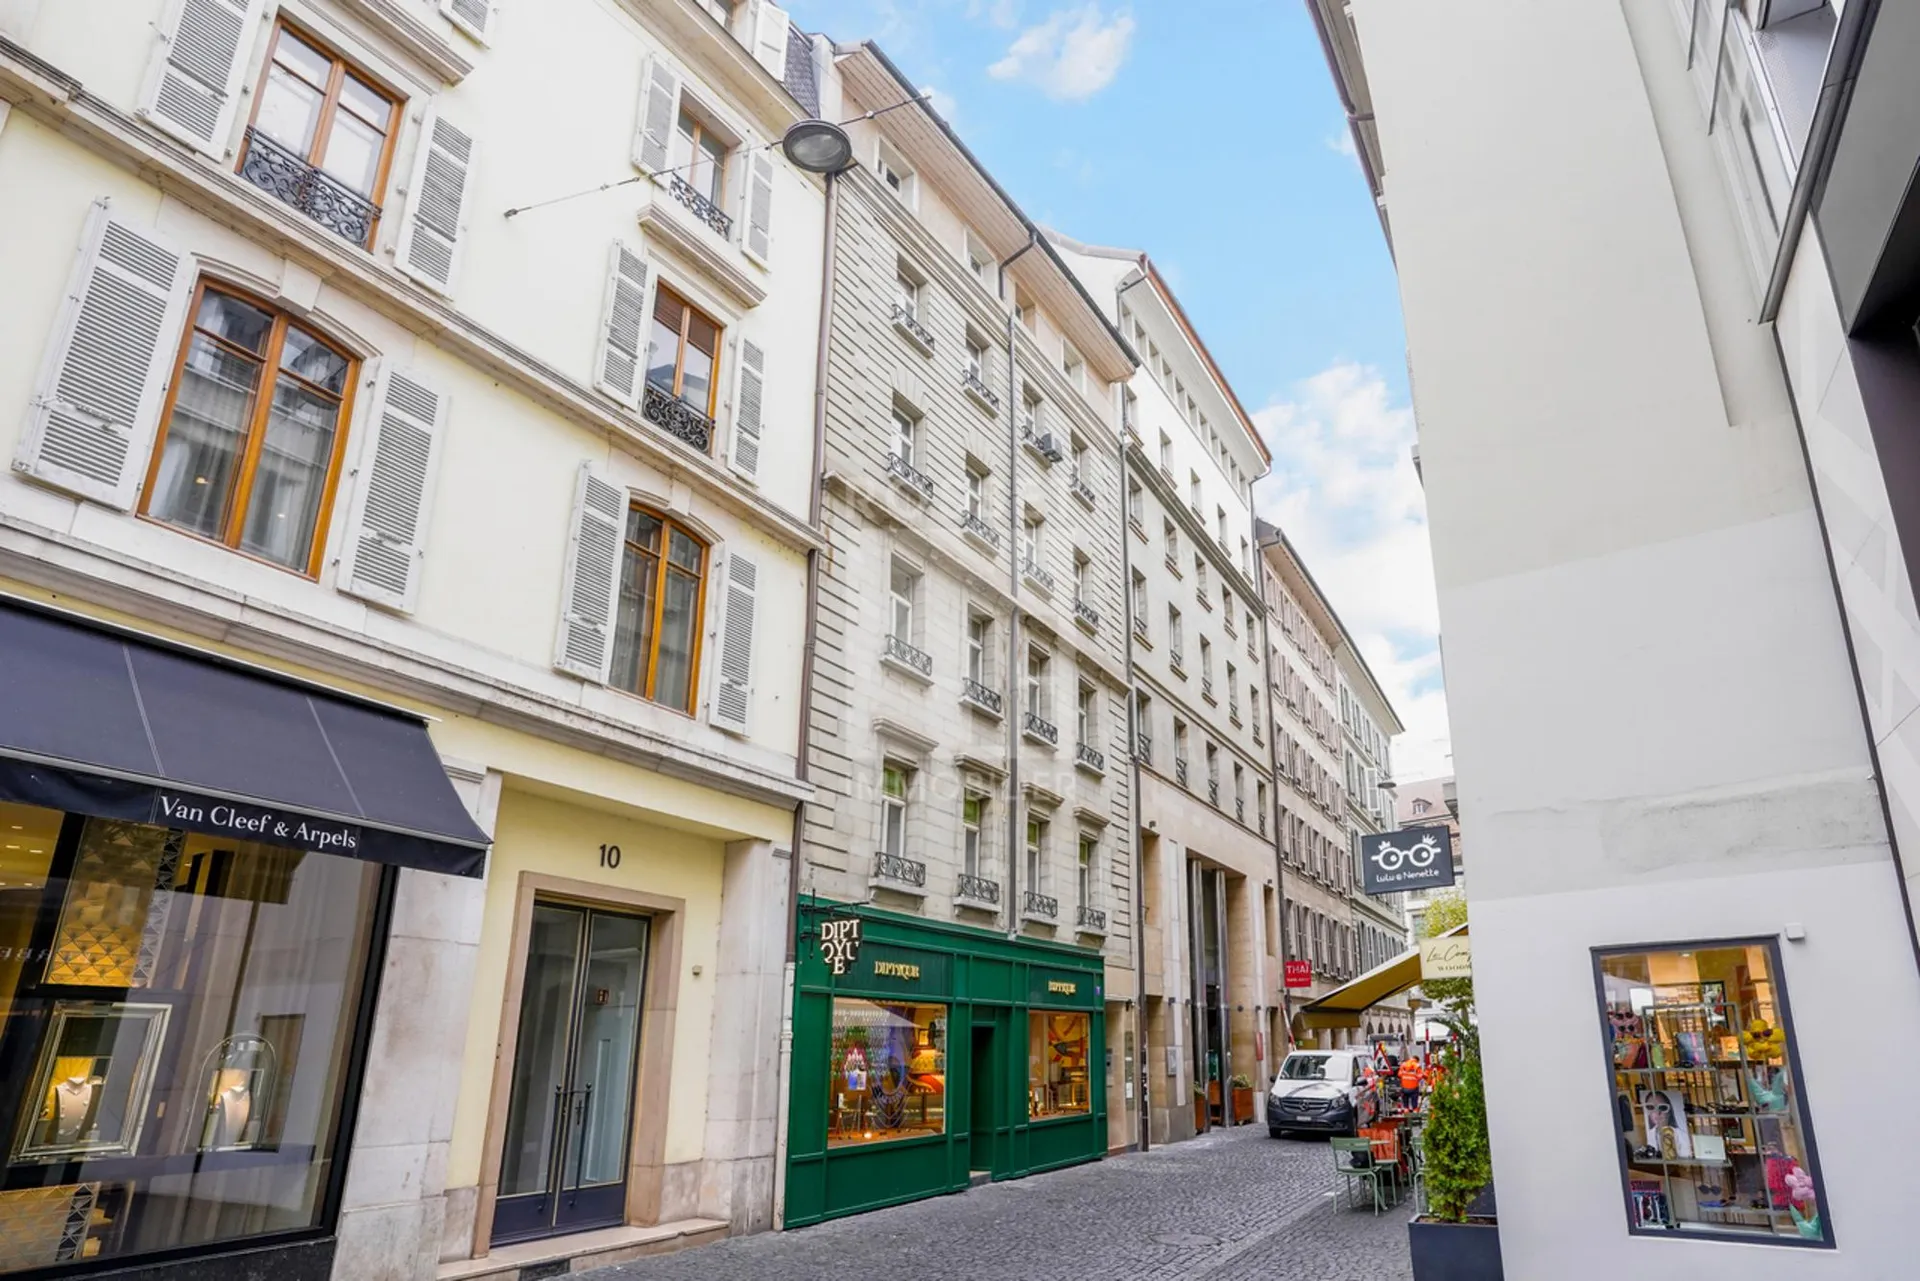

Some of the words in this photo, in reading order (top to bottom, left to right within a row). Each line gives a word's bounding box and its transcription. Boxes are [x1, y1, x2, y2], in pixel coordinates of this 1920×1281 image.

[161, 796, 203, 822] Van
[210, 805, 271, 833] Cleef
[274, 821, 290, 837] &
[293, 822, 357, 849] Arpels
[599, 843, 621, 869] 10
[820, 919, 860, 941] DIPT
